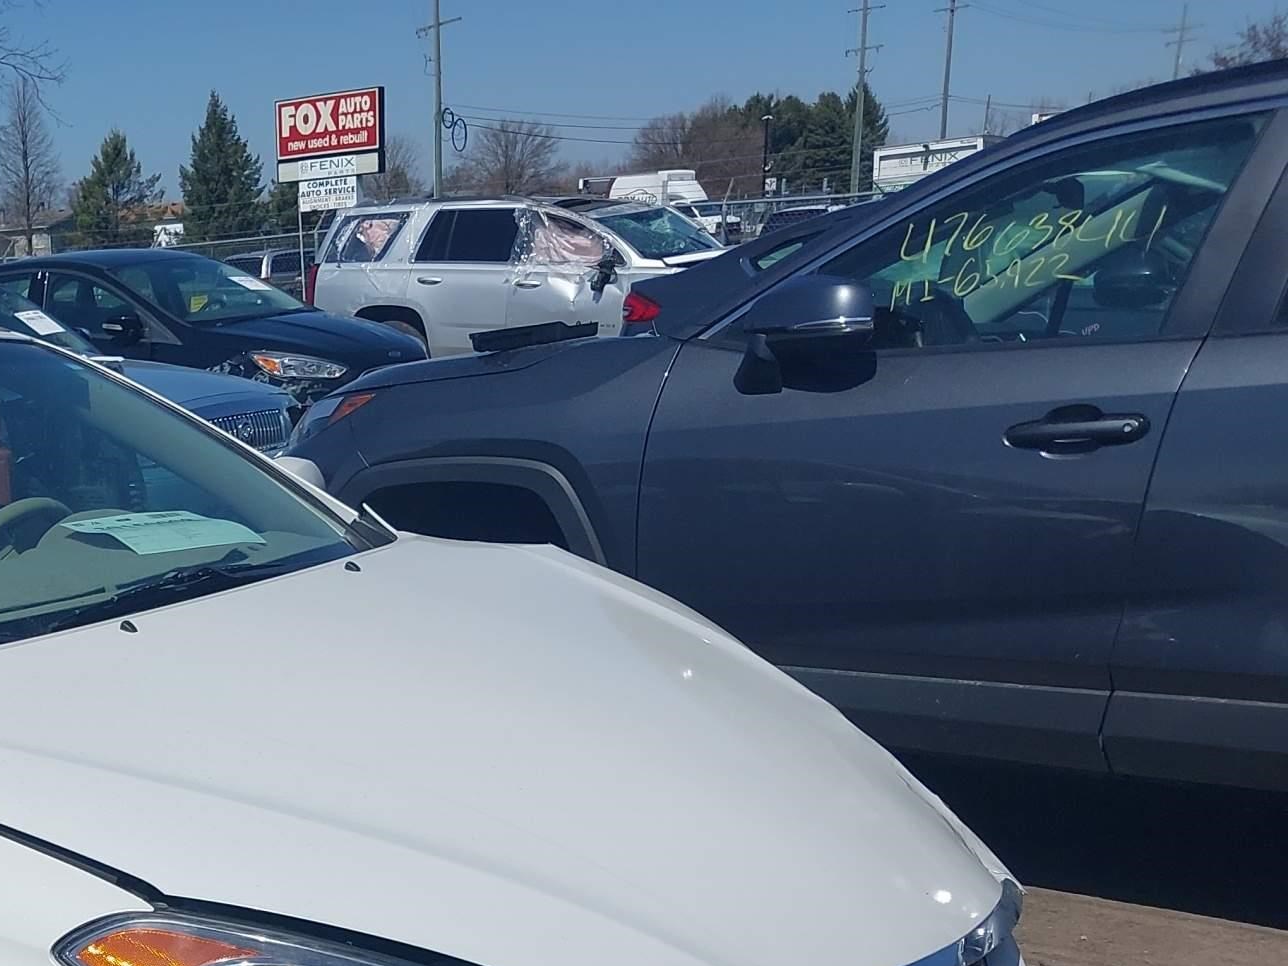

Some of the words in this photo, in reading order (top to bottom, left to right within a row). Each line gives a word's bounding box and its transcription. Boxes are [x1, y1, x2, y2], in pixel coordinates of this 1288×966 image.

[338, 95, 371, 114] AUTO
[281, 99, 337, 138] FOX
[338, 110, 375, 130] PARTS
[287, 140, 307, 151] new
[308, 134, 330, 149] used
[331, 134, 338, 146] &
[340, 130, 368, 145] rebuilt
[310, 157, 354, 171] FENIX
[307, 179, 348, 189] COMPLETE
[325, 186, 355, 195] SERVICE
